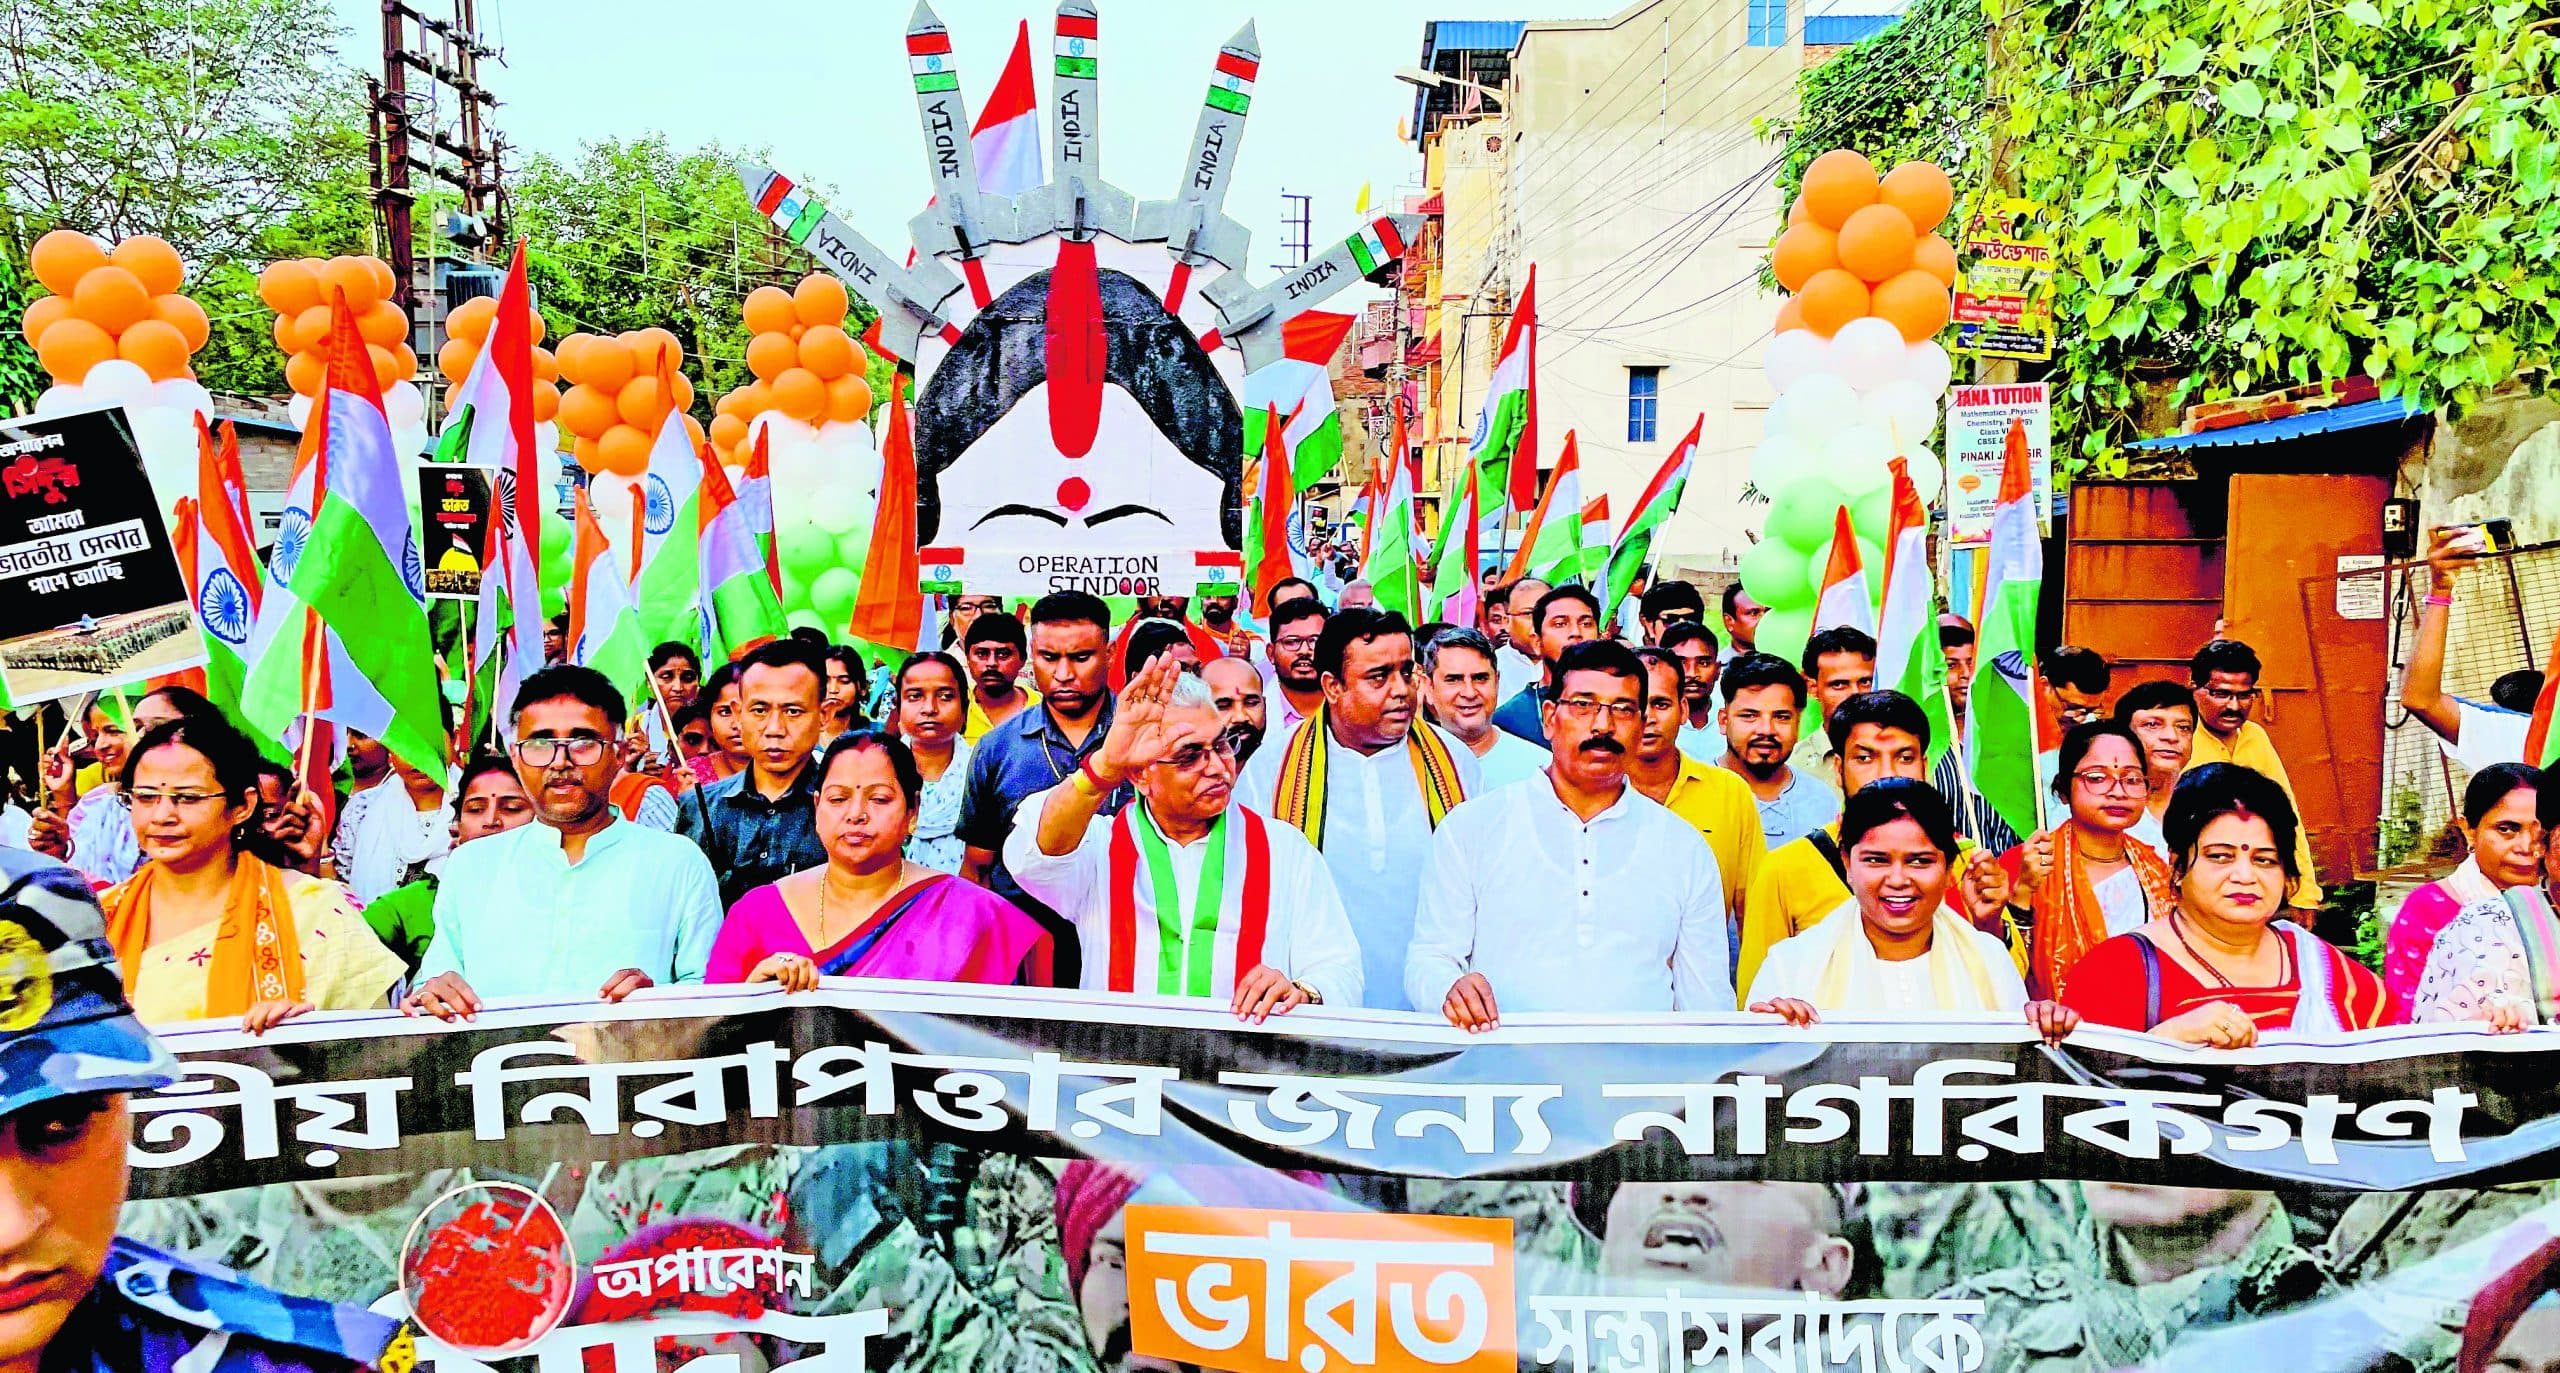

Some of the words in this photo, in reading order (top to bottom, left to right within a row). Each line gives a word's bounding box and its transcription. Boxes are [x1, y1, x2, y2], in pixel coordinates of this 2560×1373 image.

[927, 100, 960, 179] INDIA
[1060, 89, 1082, 163] INDIA
[1194, 124, 1227, 191] INDIA
[819, 227, 878, 285] INDIA
[1284, 260, 1338, 300] INDIA
[1957, 389, 1990, 407] JANA
[1992, 386, 2042, 405] TUTION
[1961, 451, 1994, 462] PINAKI
[26, 509, 86, 534] আমরা
[79, 528, 143, 557] সেনার
[28, 572, 70, 595] পাশে
[69, 560, 126, 587] আছি
[1019, 555, 1159, 574] OPERATION
[455, 1040, 1181, 1140] নিরাপত্তার
[1218, 1071, 1564, 1156] জন্য
[1602, 1059, 2478, 1165] নাগরিকগণ
[593, 1246, 816, 1299] অপারেশন
[1144, 1221, 1494, 1373] ভারত
